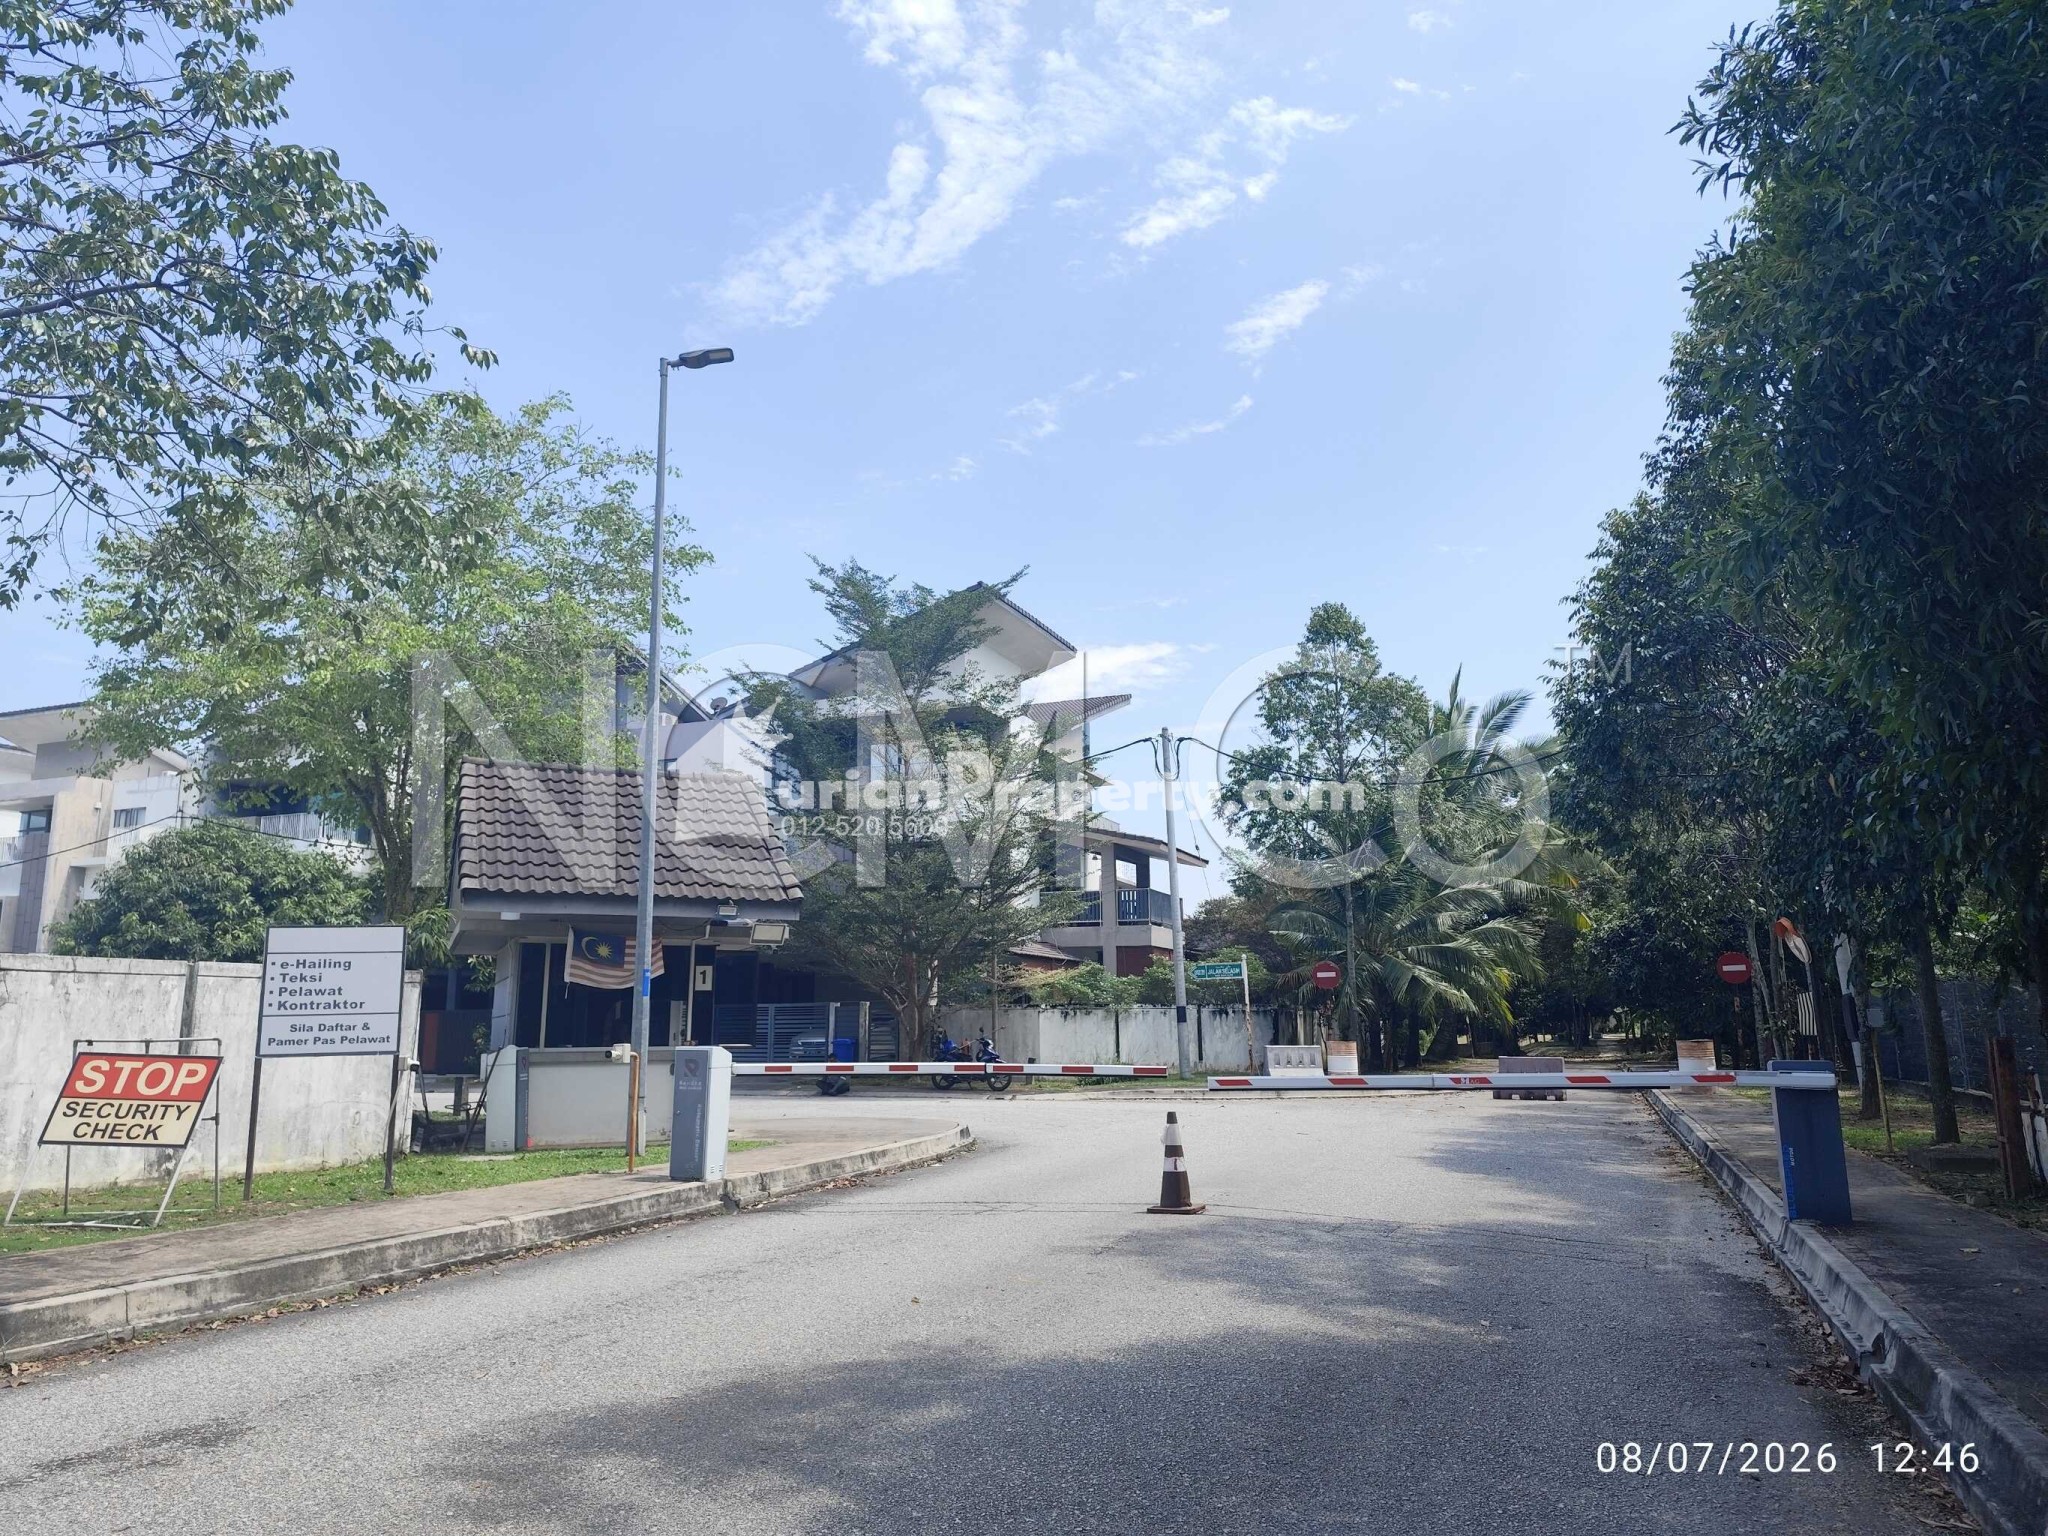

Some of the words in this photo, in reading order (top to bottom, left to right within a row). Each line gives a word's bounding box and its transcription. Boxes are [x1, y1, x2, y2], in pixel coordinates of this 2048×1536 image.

[280, 959, 352, 971] e-Hailing
[280, 973, 322, 983] Teksi
[700, 970, 706, 985] 1
[278, 986, 343, 996] Pelawat
[277, 1000, 365, 1011] Kontraktor
[289, 1024, 313, 1032] Sila
[318, 1023, 357, 1032] Daftar
[361, 1022, 370, 1031] &
[268, 1037, 309, 1046] Pamer
[313, 1036, 335, 1045] Pas
[340, 1035, 390, 1045] Pelawat
[75, 1059, 207, 1096] STOP
[62, 1101, 191, 1121] SECURITY
[73, 1122, 163, 1140] CHECK
